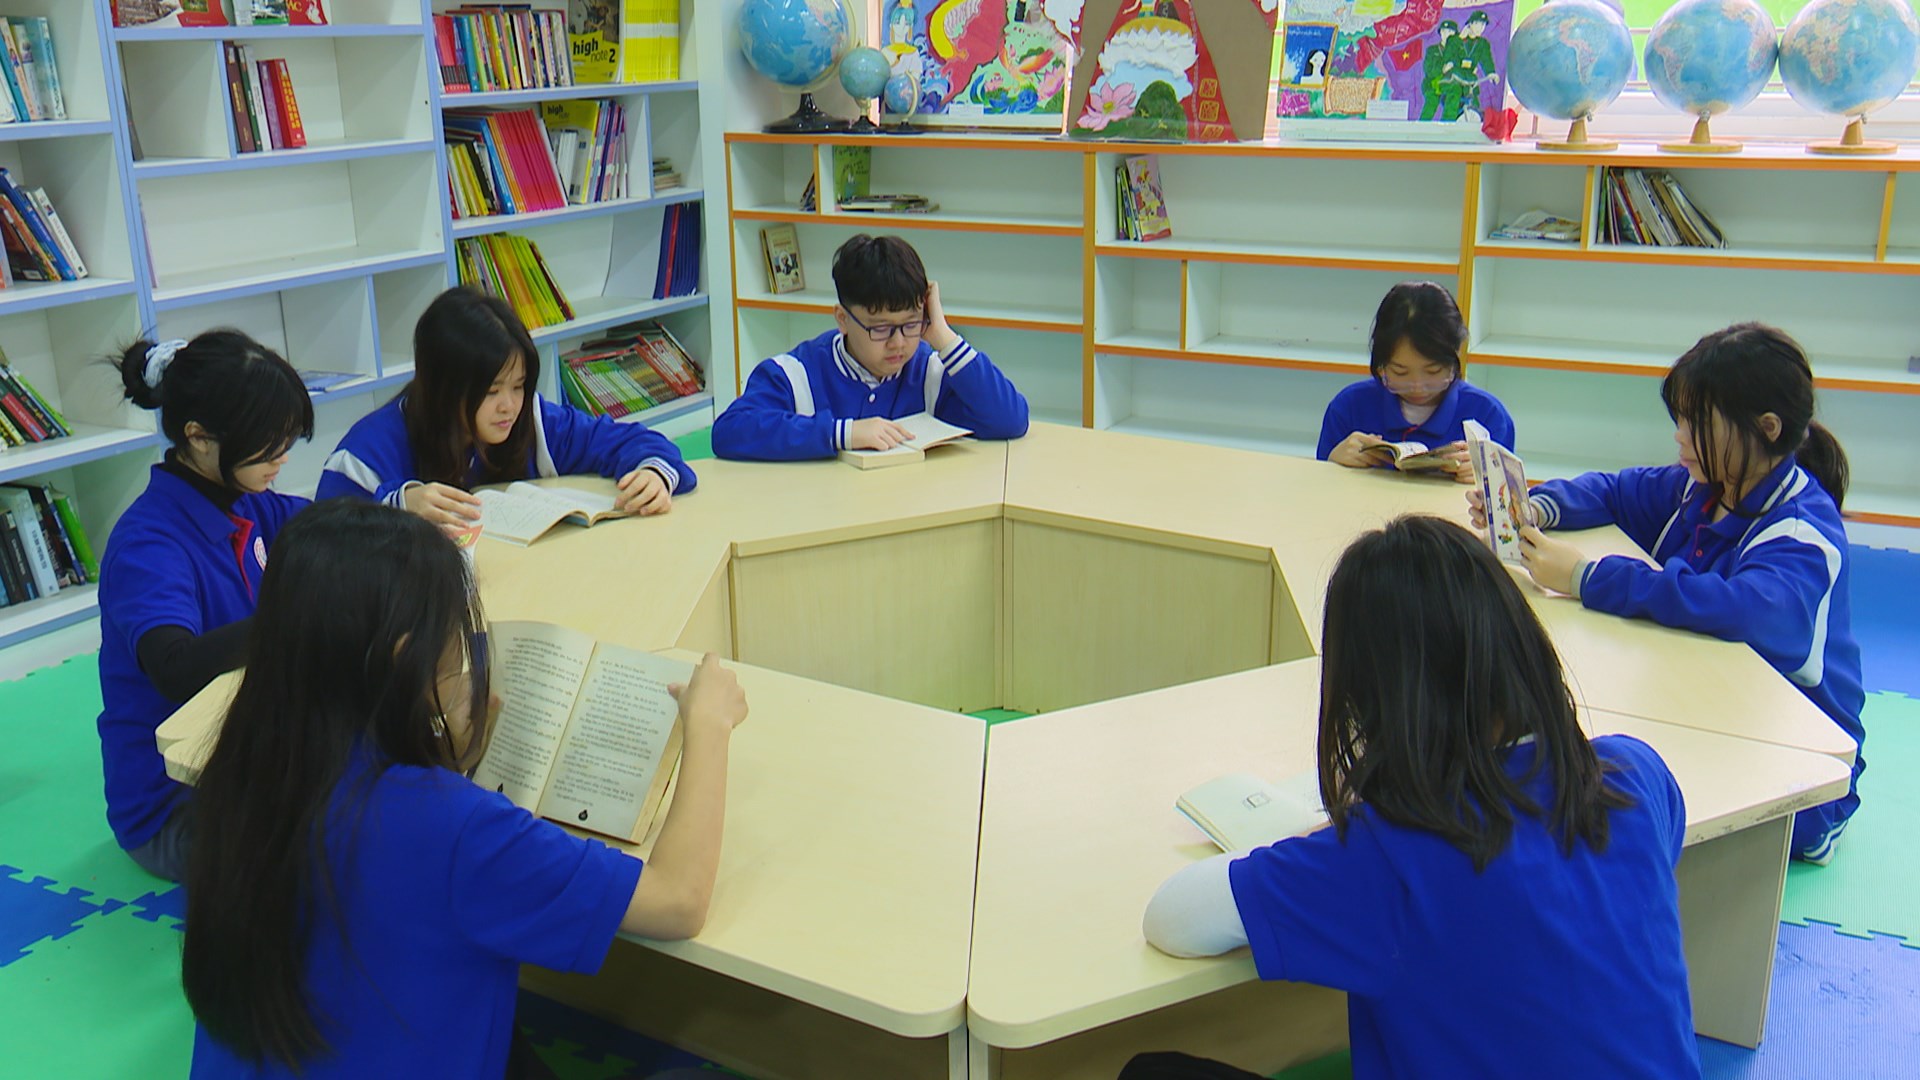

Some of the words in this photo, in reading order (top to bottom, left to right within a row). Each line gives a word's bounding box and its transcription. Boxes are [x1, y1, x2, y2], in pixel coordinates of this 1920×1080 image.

[573, 38, 598, 56] high
[590, 51, 608, 62] note
[609, 48, 616, 63] 2
[547, 104, 564, 116] high
